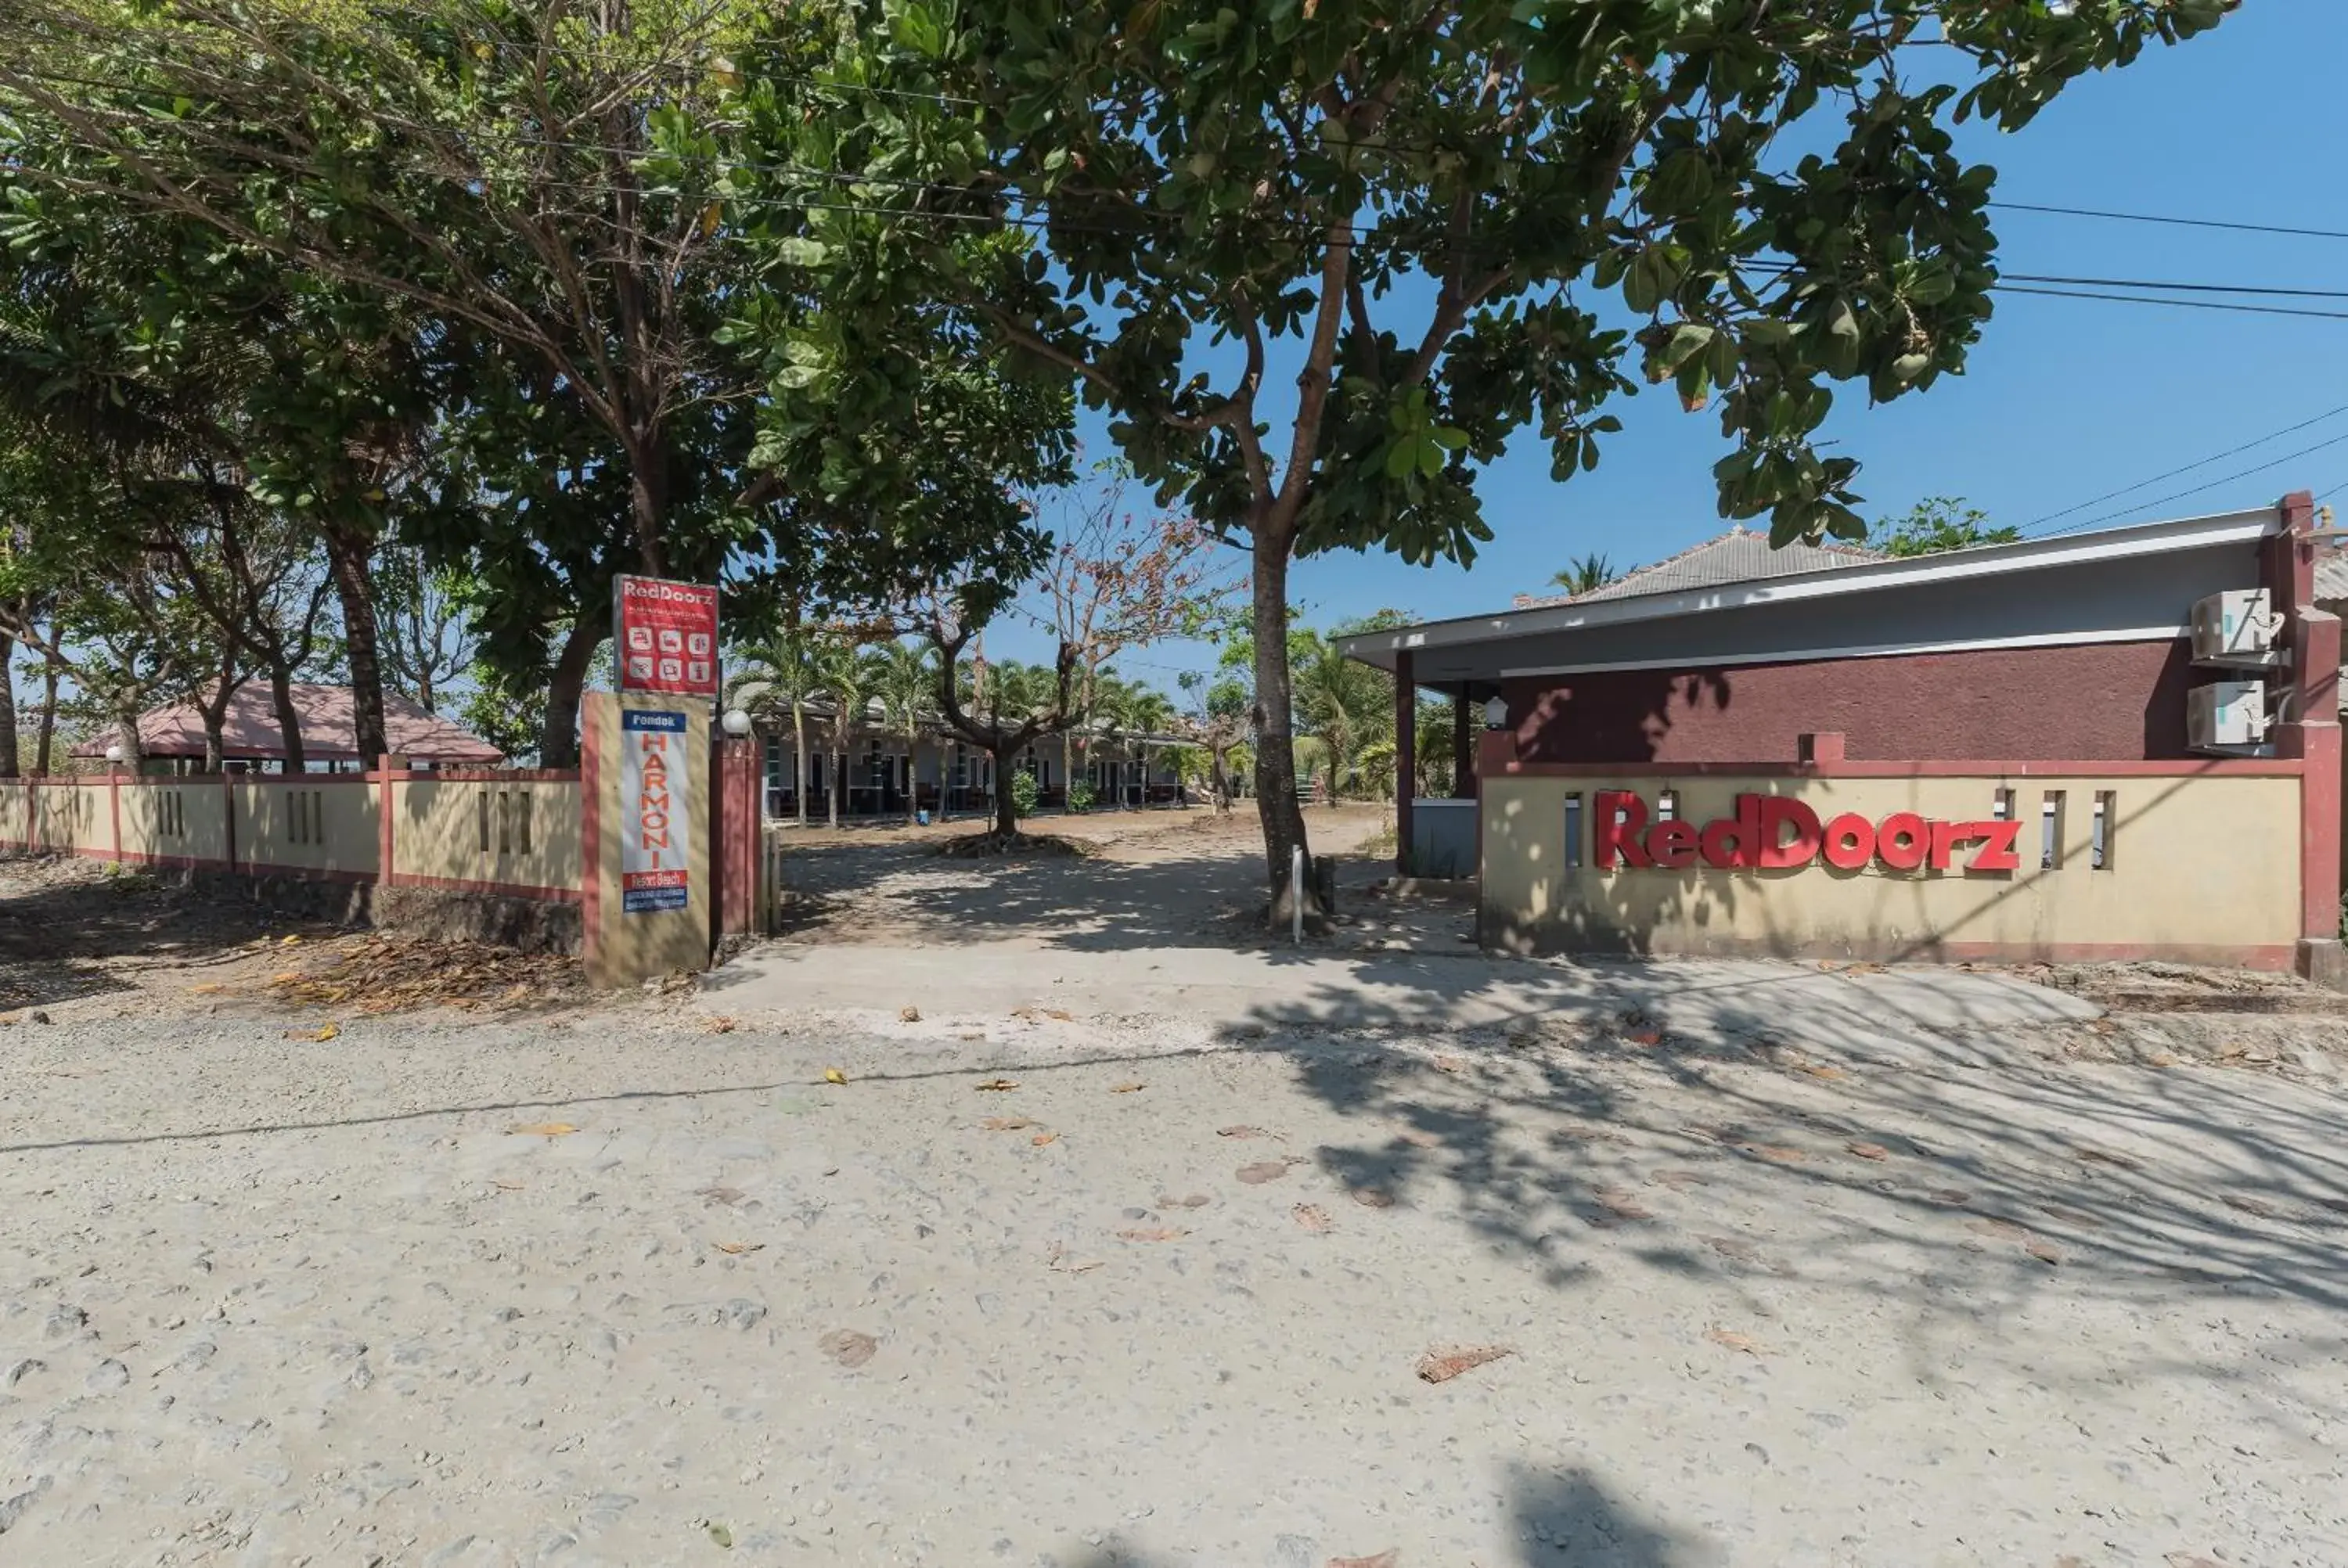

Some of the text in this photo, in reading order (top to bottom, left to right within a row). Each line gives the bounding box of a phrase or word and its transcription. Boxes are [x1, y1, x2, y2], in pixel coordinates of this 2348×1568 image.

[624, 581, 713, 605] RedDoorz
[633, 714, 675, 727] Pondok
[640, 732, 670, 869] HARMONI
[1594, 789, 2024, 870] RedDoorz
[657, 871, 680, 886] Beach
